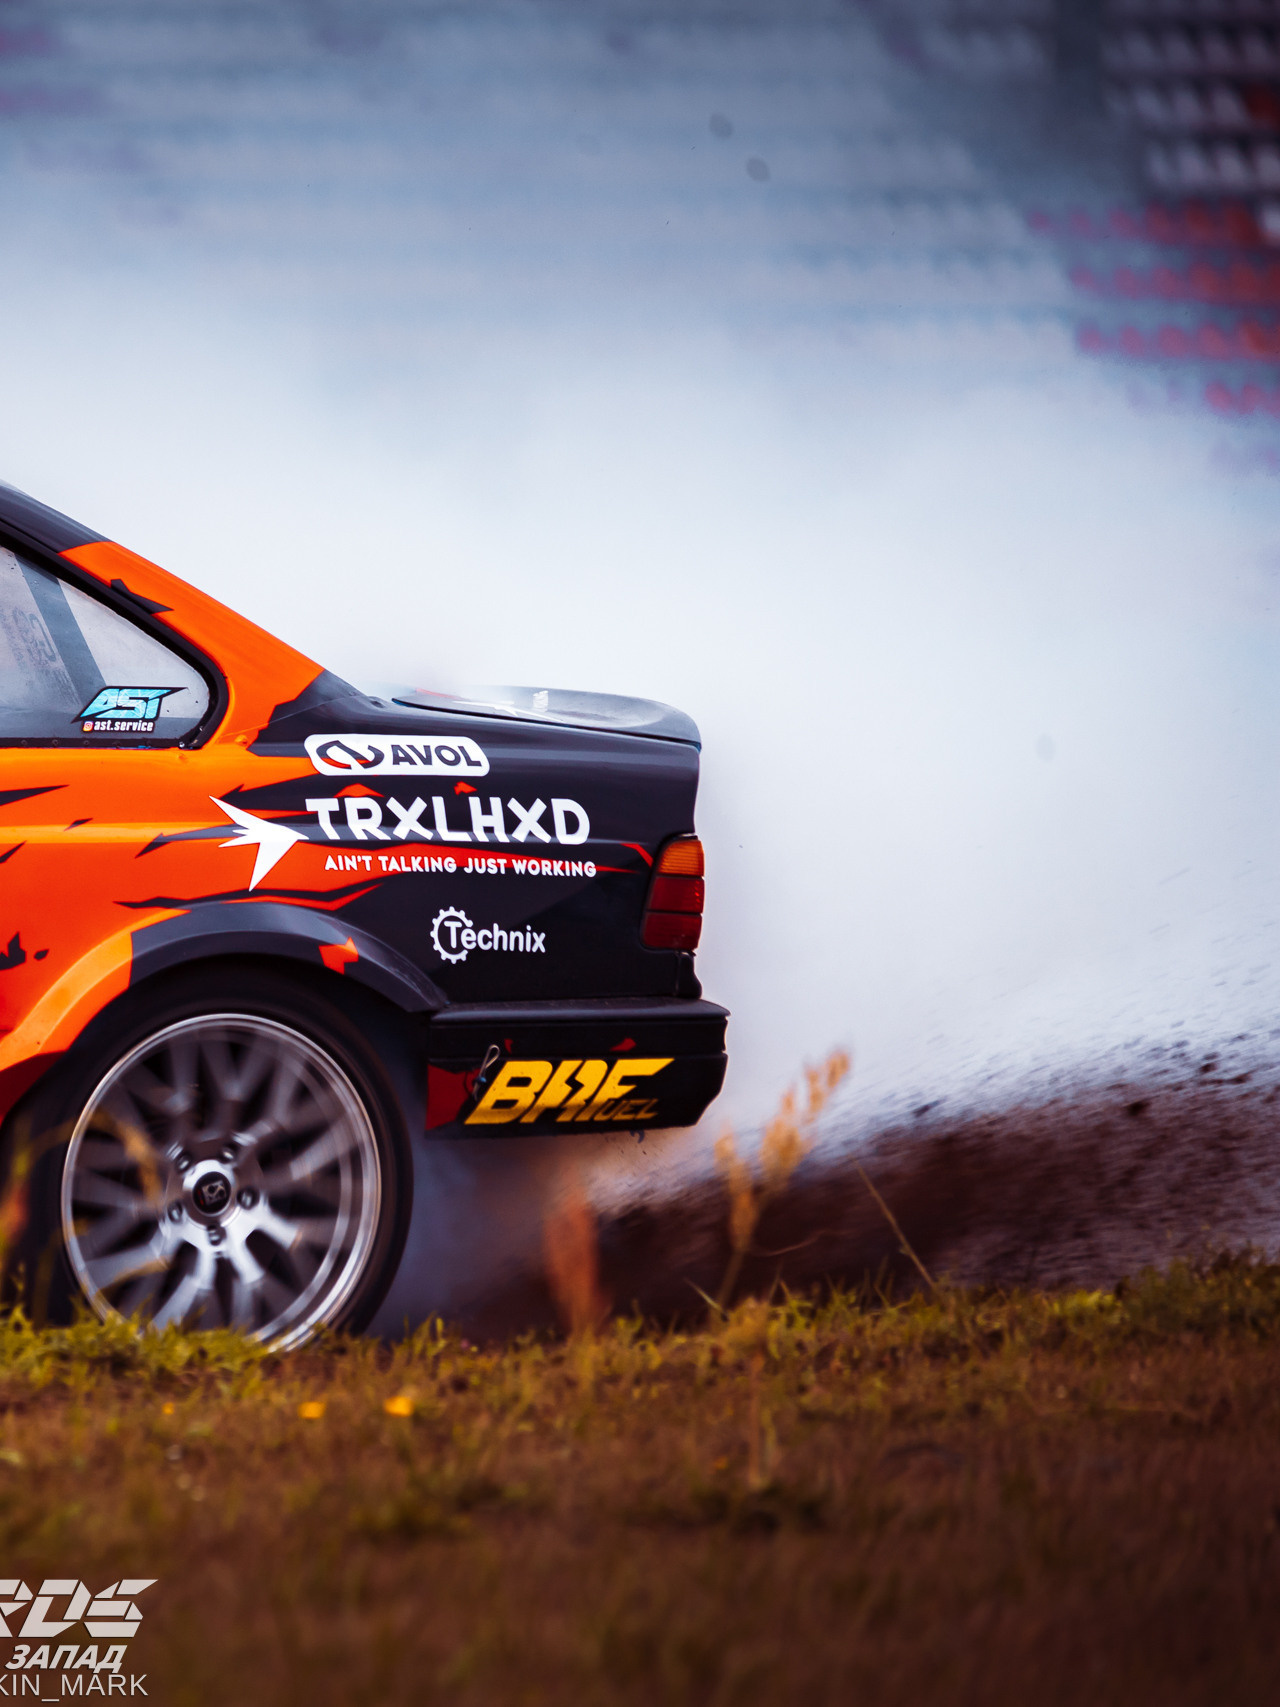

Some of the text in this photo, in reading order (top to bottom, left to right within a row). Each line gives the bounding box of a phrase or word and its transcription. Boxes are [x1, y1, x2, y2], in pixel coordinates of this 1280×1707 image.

[392, 744, 482, 767] AVOL
[305, 796, 590, 845] TRXLHXD
[324, 855, 597, 878] AIN'T TALKING JUST WORKING
[443, 920, 546, 953] Technix
